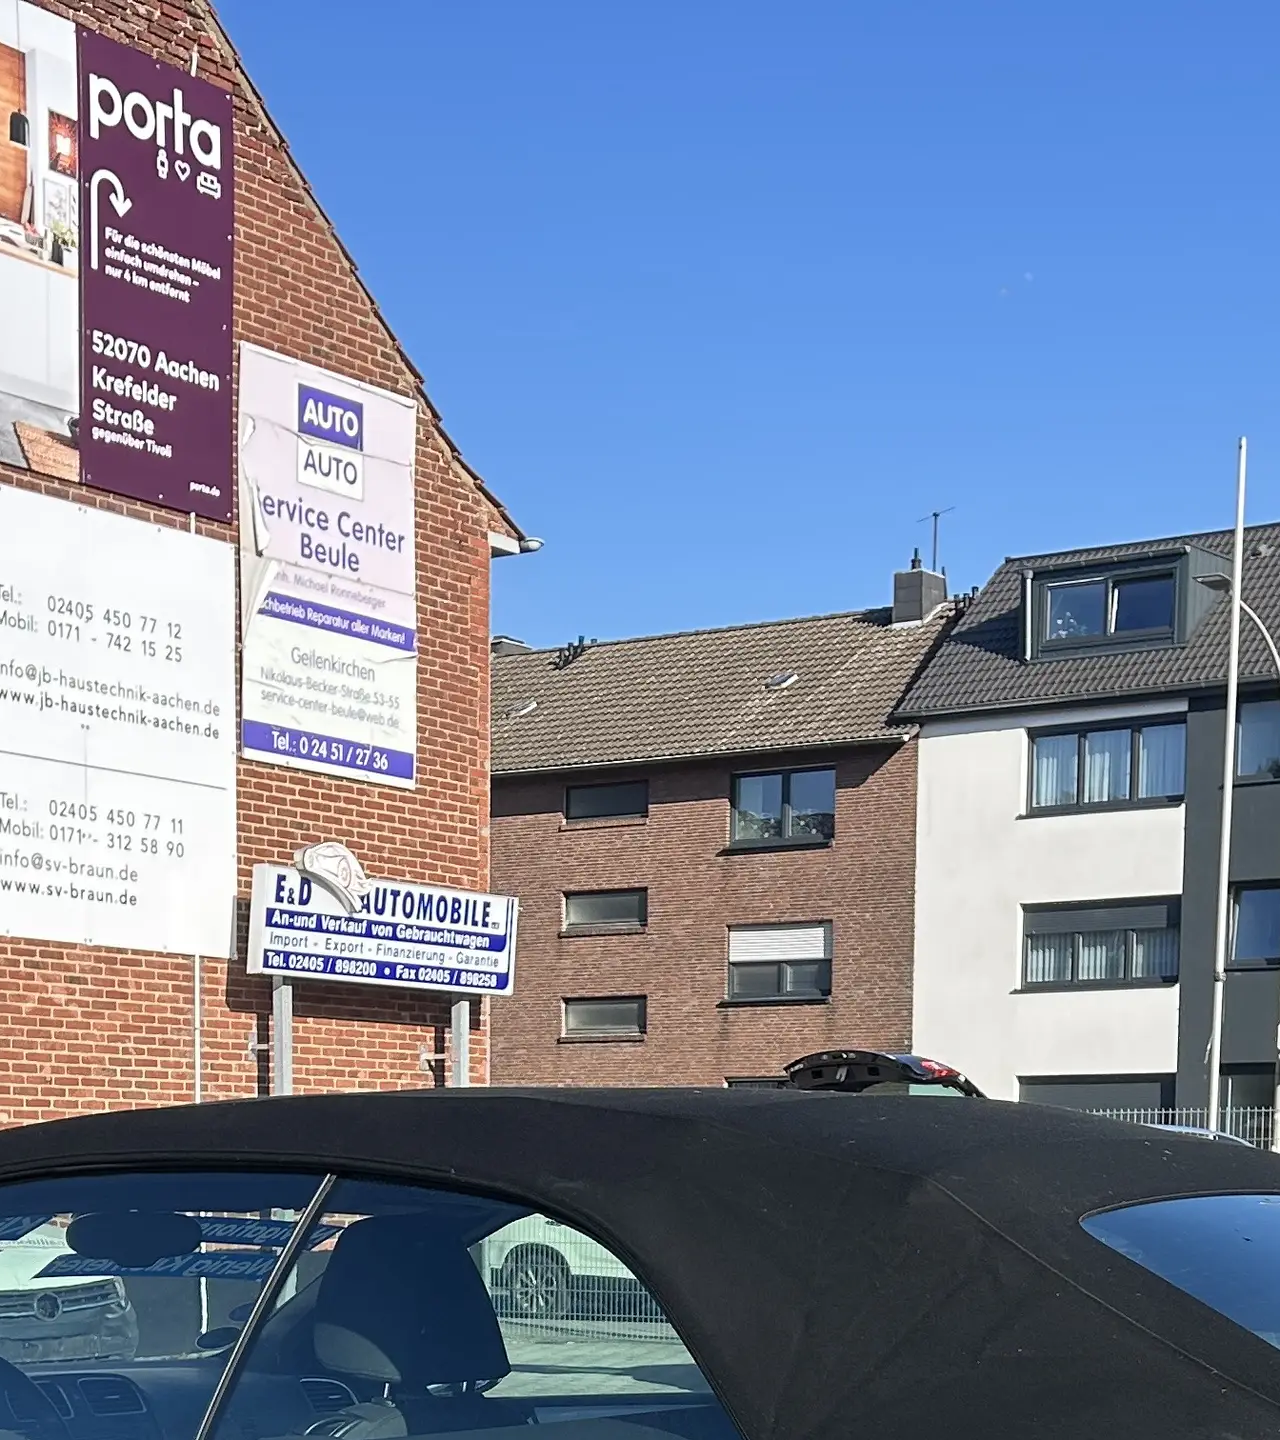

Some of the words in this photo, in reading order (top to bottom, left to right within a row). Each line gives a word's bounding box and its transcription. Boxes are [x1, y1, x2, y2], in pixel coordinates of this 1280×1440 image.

[89, 73, 221, 170] porta
[105, 226, 123, 243] Für
[124, 235, 140, 250] die
[141, 243, 190, 269] schönsten
[191, 258, 221, 280] Möbel
[105, 246, 142, 269] einfach
[143, 260, 192, 286] umdrehen
[105, 265, 122, 279] nur
[123, 269, 131, 282] 4
[132, 271, 148, 288] km
[149, 280, 190, 303] entfernt
[92, 330, 151, 368] 52070
[154, 351, 220, 391] Aachen
[92, 366, 177, 411] Krefelder
[92, 398, 154, 435] Straße
[303, 398, 359, 437] AUTO
[92, 426, 145, 450] gegenüber
[145, 438, 172, 458] Tivoli
[303, 449, 358, 485] AUTO
[189, 481, 221, 497] porta.de
[262, 494, 329, 531] ervice
[337, 511, 405, 553] Center
[301, 533, 360, 572] Beule
[274, 570, 291, 583] nh.
[294, 574, 329, 595] Michael
[47, 595, 93, 622] 02405
[103, 608, 131, 629] 450
[140, 616, 157, 634] 77
[168, 622, 182, 639] 12
[307, 607, 350, 630] Reparatur
[351, 619, 370, 635] aller
[371, 624, 406, 645] Marken!
[47, 620, 80, 642] 0171
[106, 632, 132, 652] 742
[142, 640, 156, 657] 15
[165, 645, 182, 663] 25
[291, 646, 376, 682] Geilenkirchen
[260, 666, 371, 702] Nikolaus-Becker-Straße
[373, 691, 400, 710] 53-55
[271, 731, 297, 753] Tel.:
[299, 737, 309, 754] 0
[311, 739, 327, 758] 24
[330, 743, 343, 761] 51
[346, 747, 353, 762] /
[356, 748, 371, 766] 27
[373, 752, 389, 770] 36
[0, 791, 27, 812] Tel.:
[49, 799, 98, 822] 02405
[106, 808, 135, 827] 450
[143, 813, 161, 831] 77
[171, 818, 183, 834] 11
[49, 824, 82, 845] 0171
[107, 832, 132, 851] 312
[140, 837, 158, 855] 58
[166, 840, 185, 858] 90
[0, 848, 138, 882] info@sv-braun.de
[0, 878, 137, 906] www.sv-braun.de
[361, 886, 491, 928] AUTOMOBILE
[271, 909, 317, 930] An-und
[321, 915, 367, 935] Verkauf
[371, 923, 393, 938] von
[396, 921, 490, 949] Gebrauchtwagen
[267, 951, 287, 968] Tel.
[288, 952, 324, 972] 02405
[395, 964, 417, 981] Fax
[419, 966, 451, 984] 02405
[270, 931, 308, 948] Import
[325, 940, 364, 955] Export
[376, 943, 445, 965] Finanzierung
[456, 951, 499, 968] Garantie
